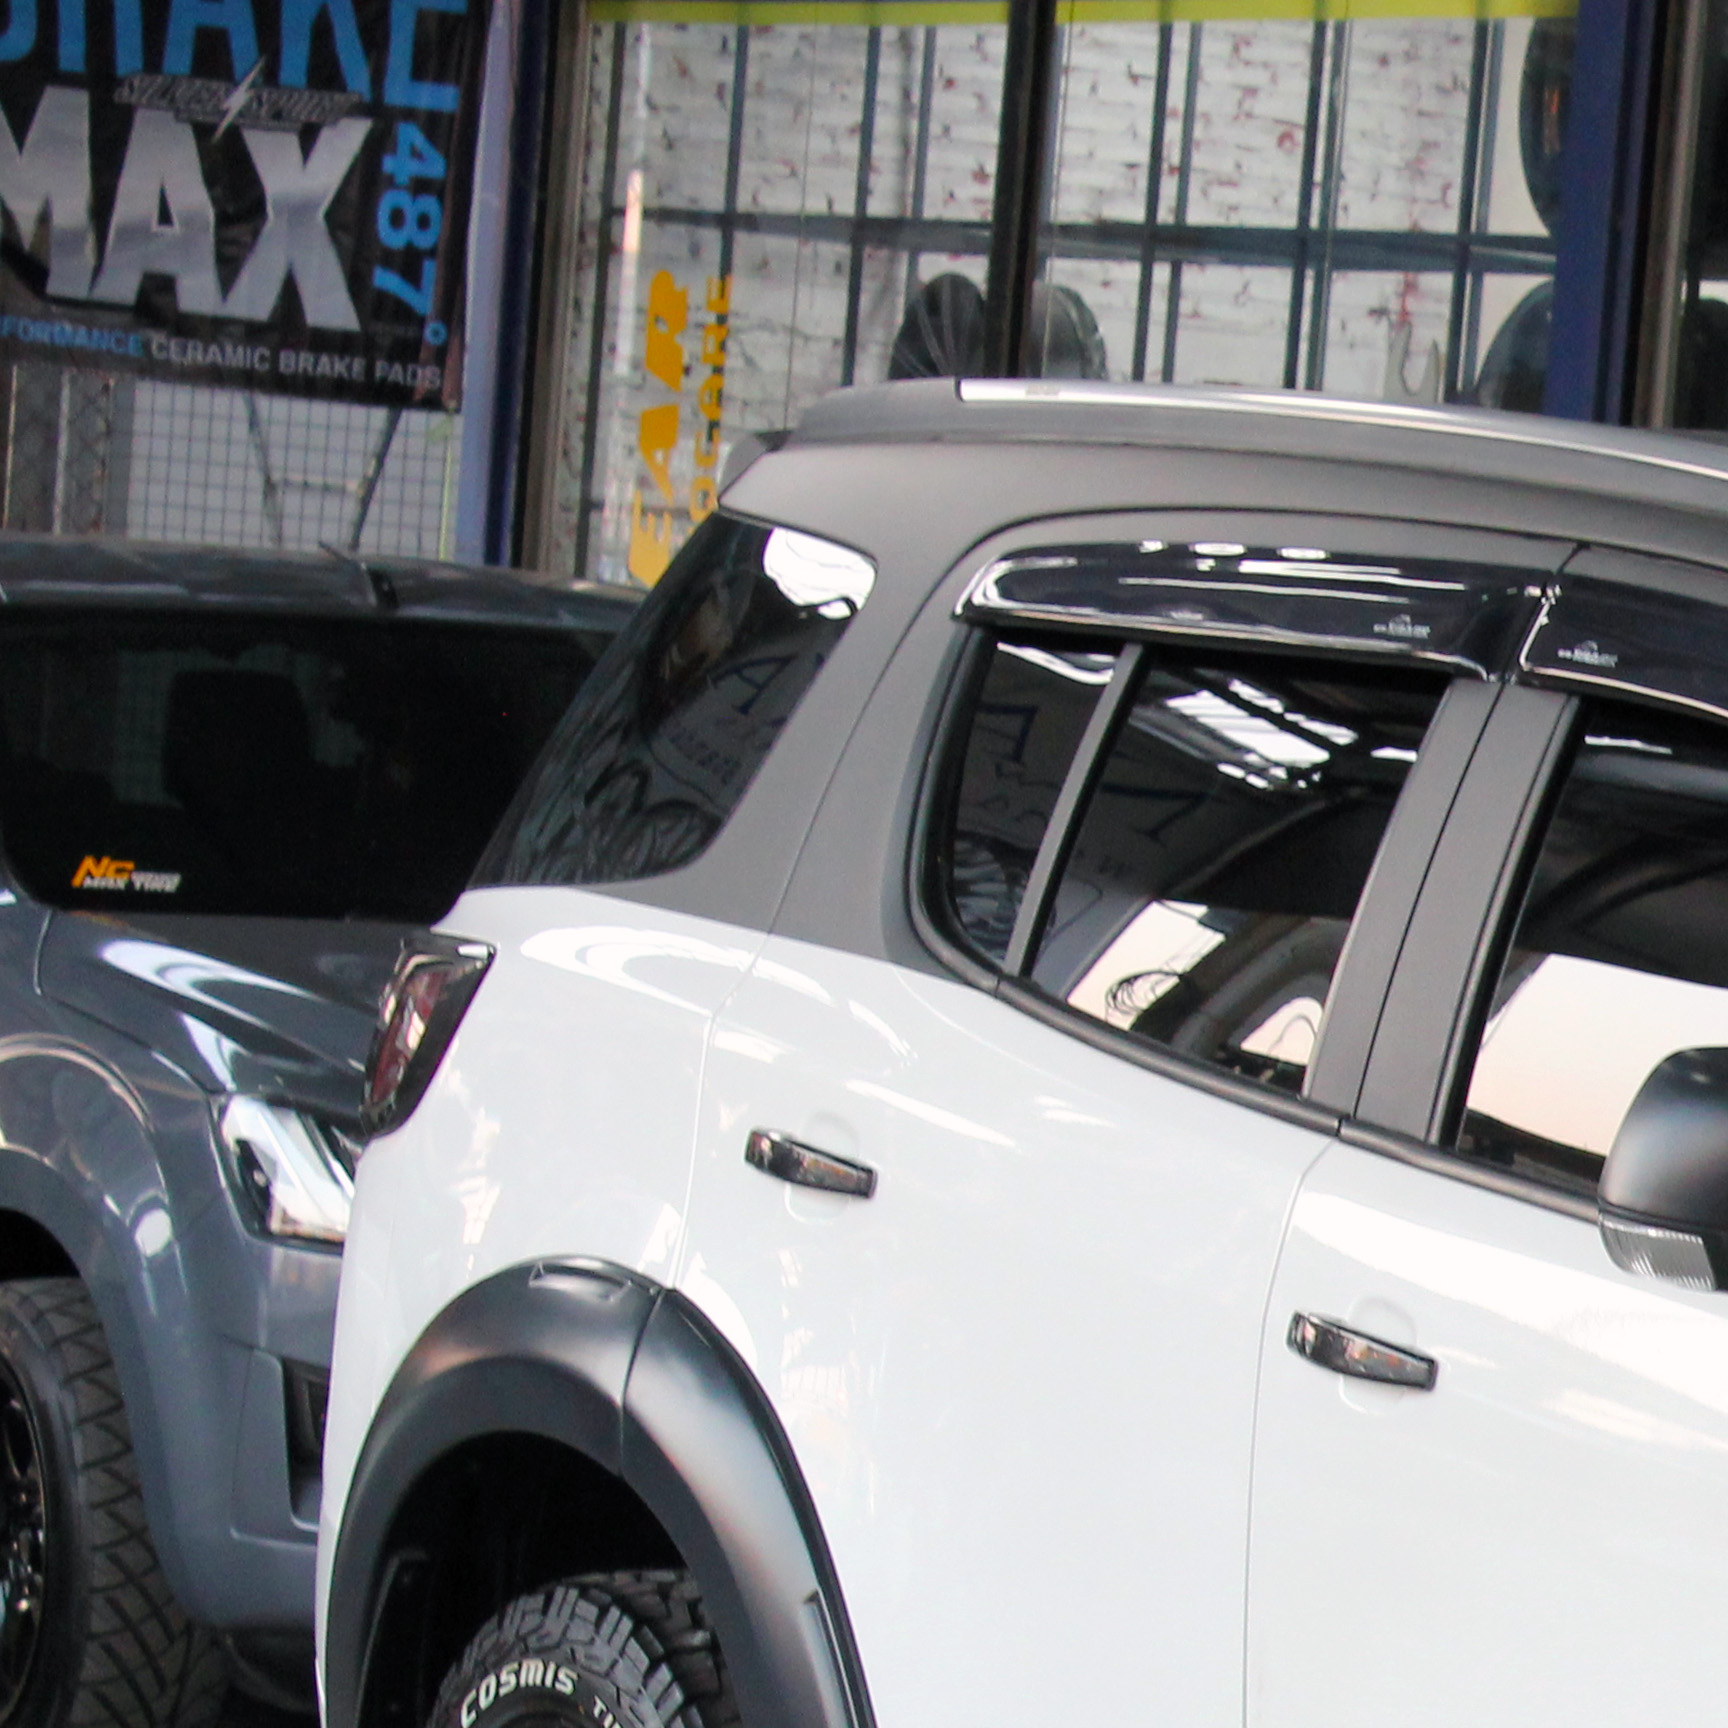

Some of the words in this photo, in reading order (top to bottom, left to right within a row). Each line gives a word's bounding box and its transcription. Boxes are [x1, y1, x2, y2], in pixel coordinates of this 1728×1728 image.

[151, 331, 272, 371] CERAMIC
[278, 349, 367, 382] BRAKE
[375, 359, 441, 390] PADS
[71, 855, 136, 889] NC
